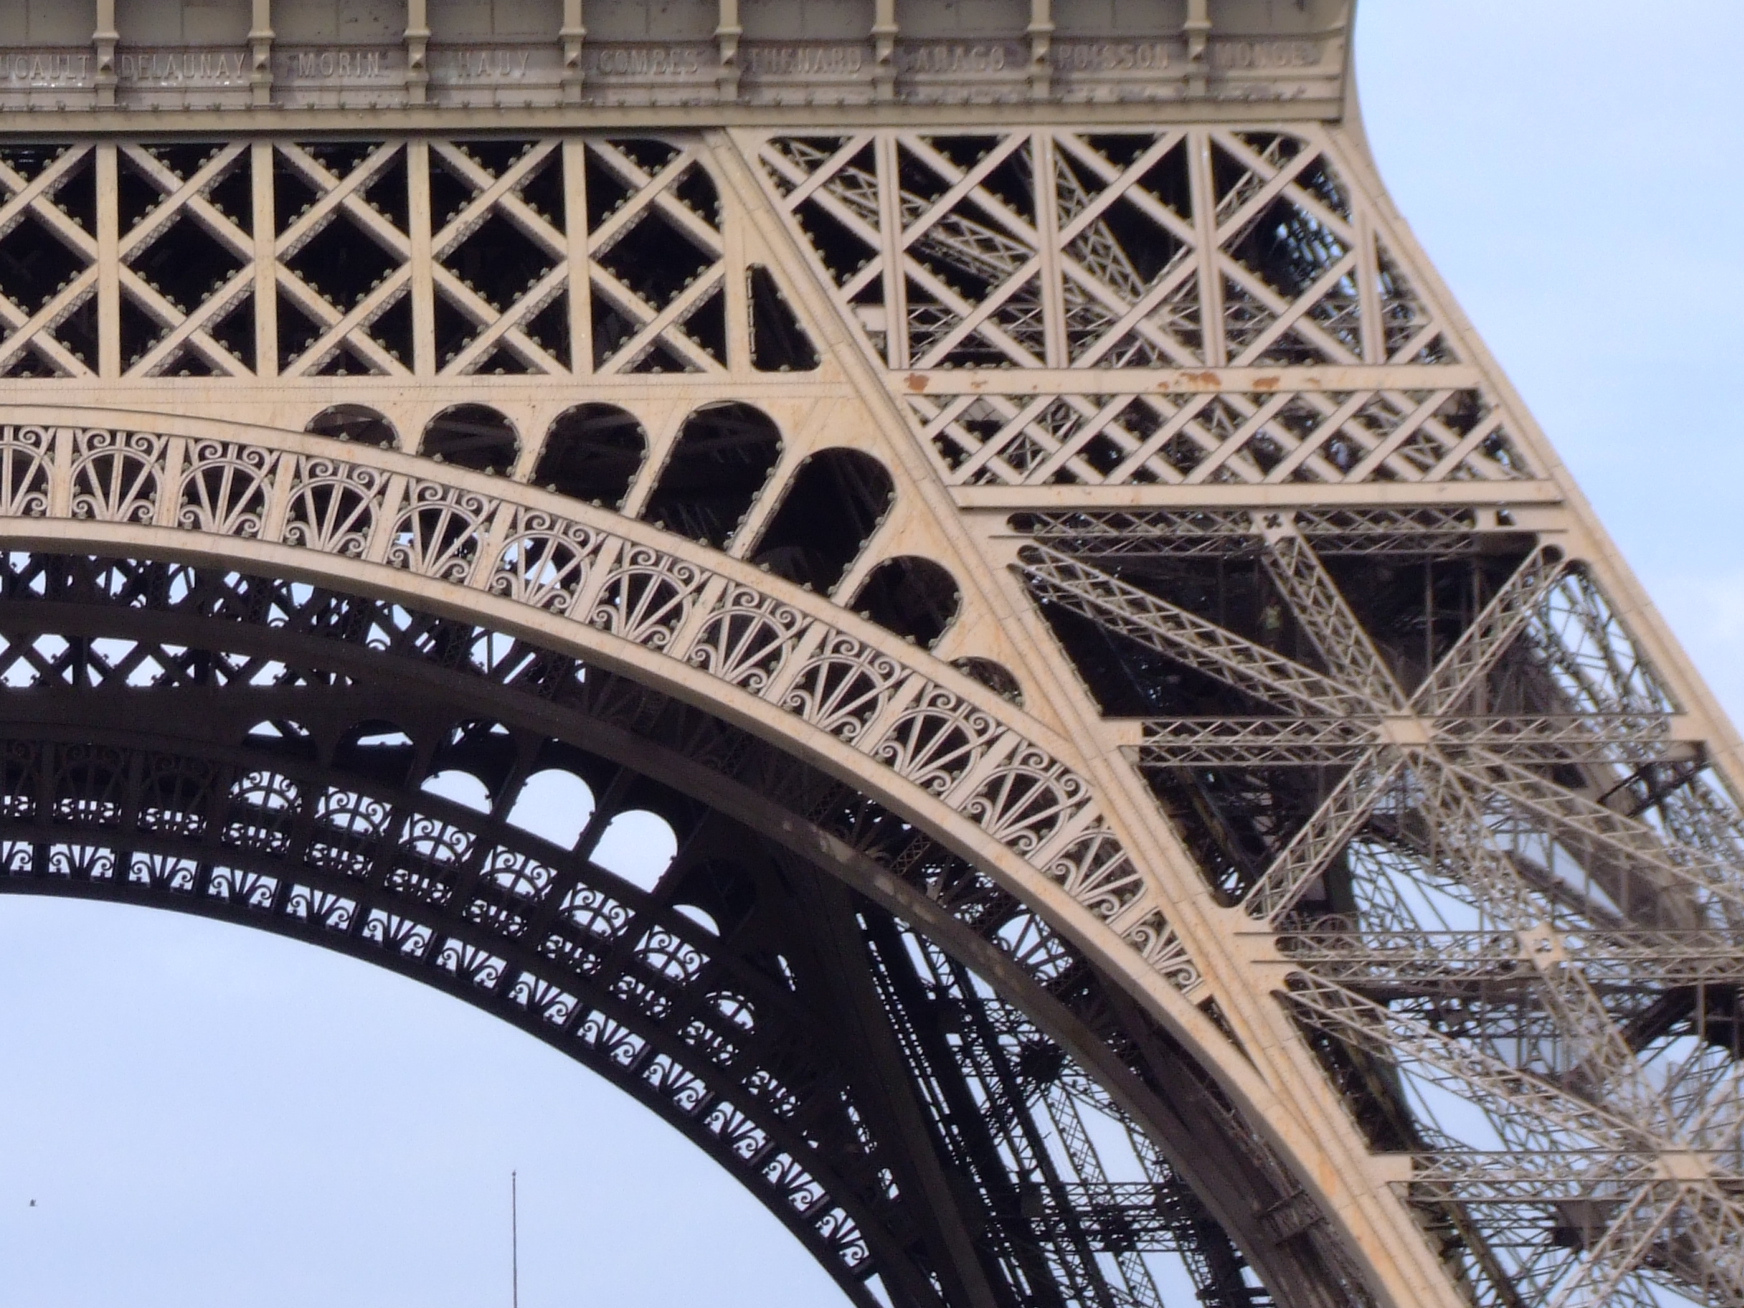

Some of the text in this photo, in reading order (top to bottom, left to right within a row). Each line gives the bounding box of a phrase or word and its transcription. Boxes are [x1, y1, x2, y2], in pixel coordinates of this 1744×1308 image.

[120, 53, 247, 79] DELAUNAY
[298, 52, 380, 78] MORIN
[597, 50, 698, 75] COMBES
